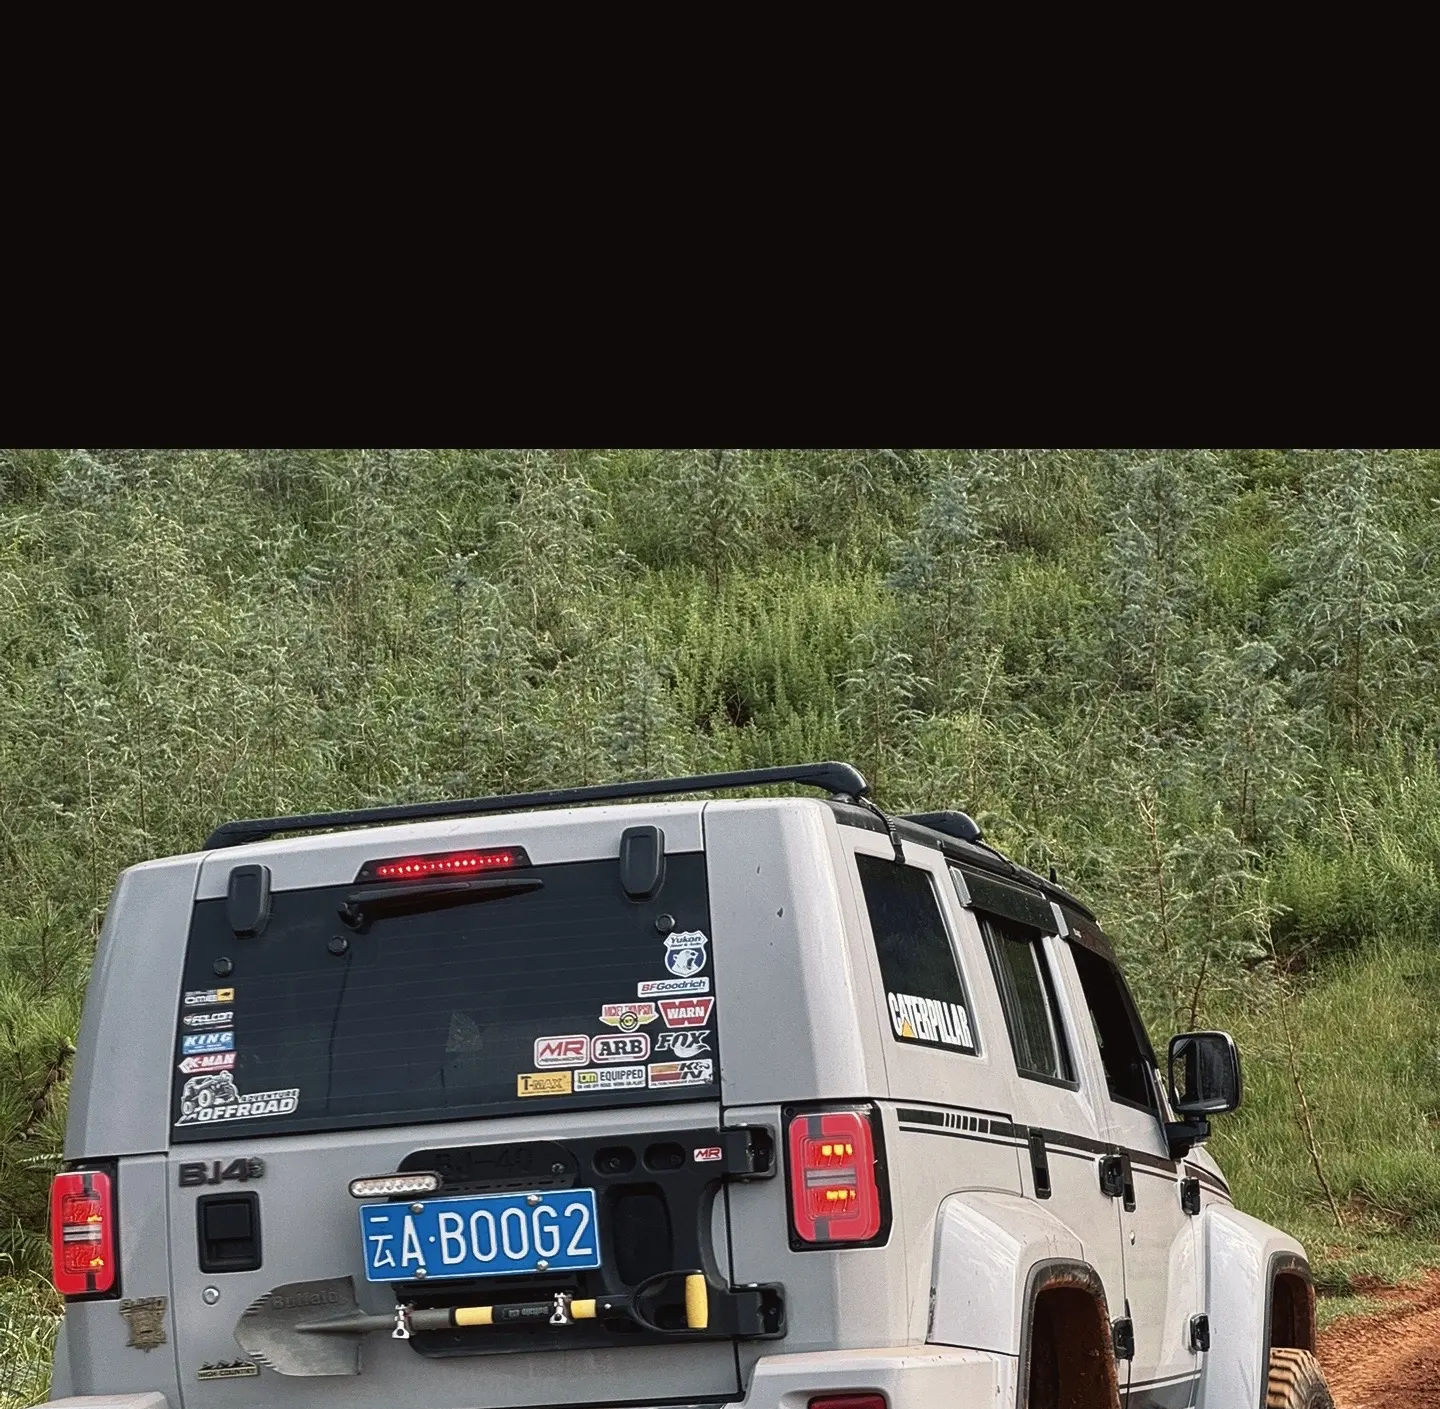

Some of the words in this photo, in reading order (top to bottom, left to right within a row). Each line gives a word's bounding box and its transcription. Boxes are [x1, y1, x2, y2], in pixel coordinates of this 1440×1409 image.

[671, 936, 702, 944] Yukon
[641, 979, 706, 991] BFGoodrich
[667, 1006, 705, 1019] WARN
[888, 991, 974, 1048] CATERPILLAR
[184, 1033, 233, 1047] KING
[656, 1031, 710, 1053] FOX
[540, 1040, 585, 1057] MR
[598, 1039, 643, 1056] ARB
[189, 1053, 237, 1068] K-MAN
[600, 1069, 644, 1081] EQUIPPED
[521, 1075, 563, 1091] T-MAX
[240, 1089, 299, 1102] ADVENTURE
[197, 1098, 295, 1121] OFFROAD
[695, 1148, 720, 1159] MR
